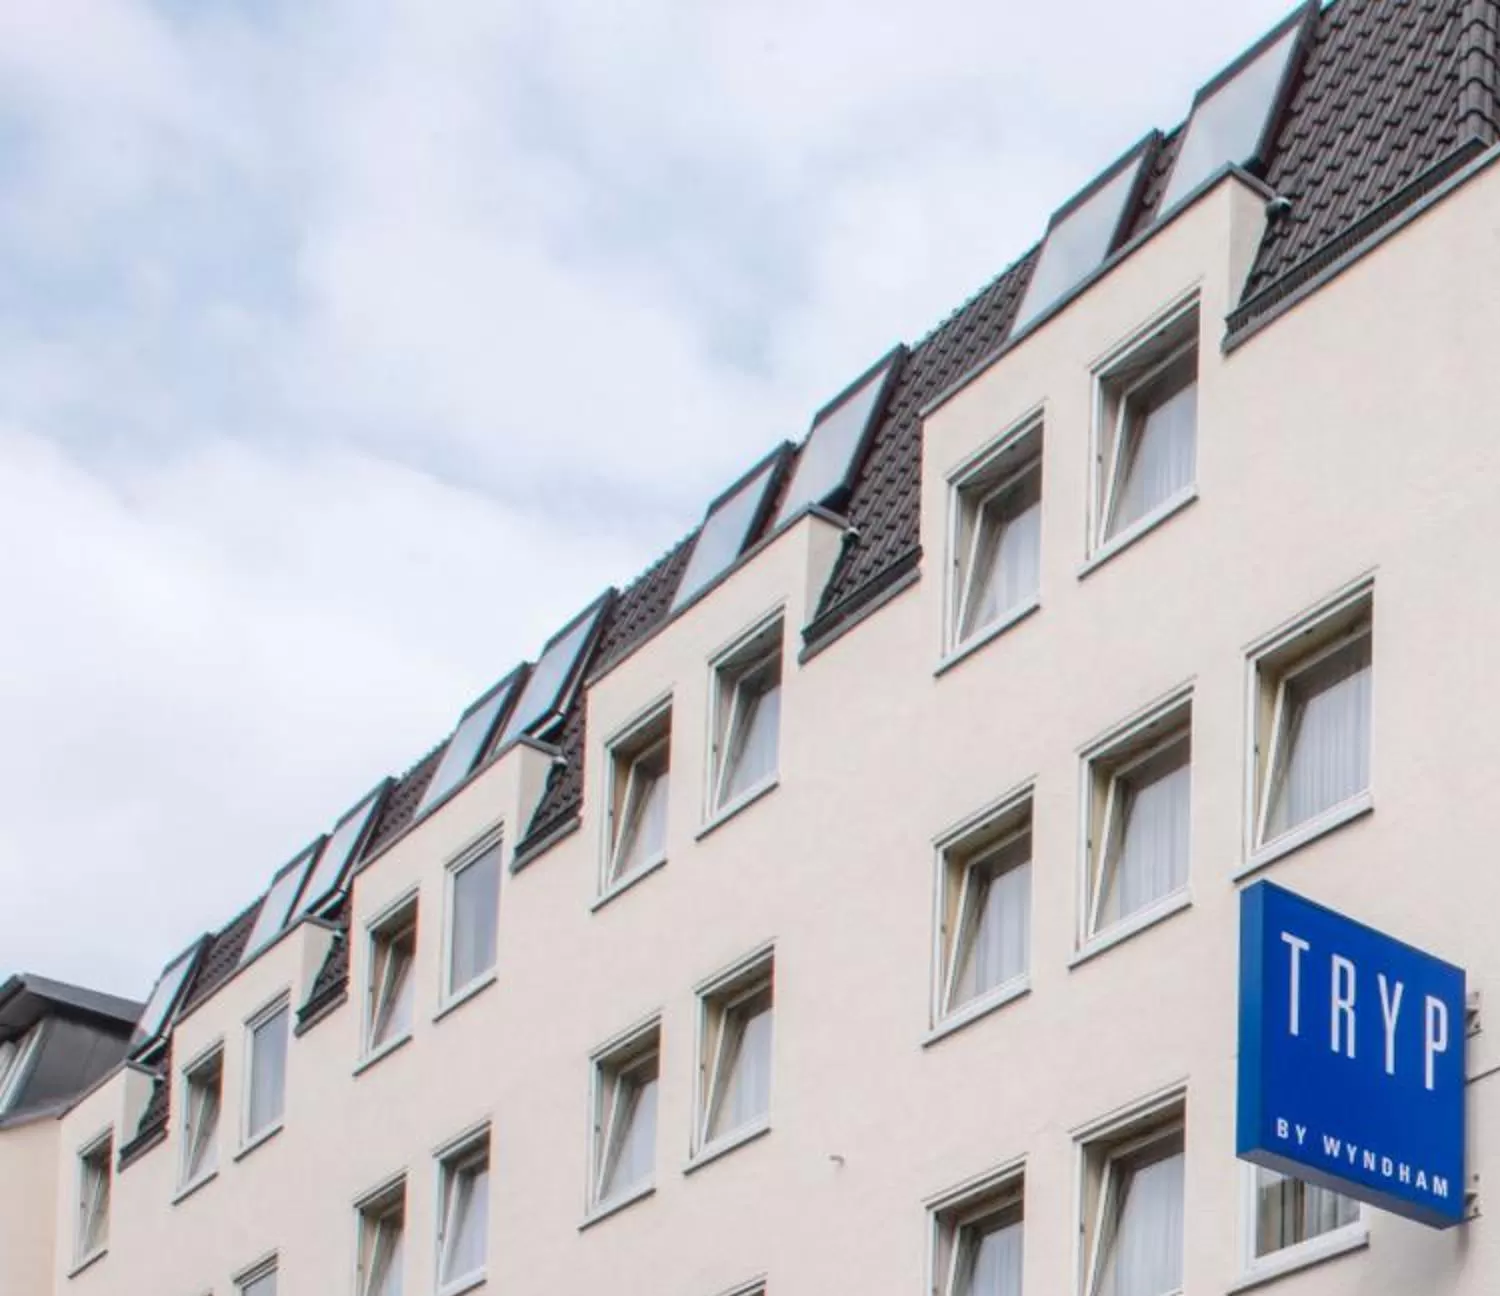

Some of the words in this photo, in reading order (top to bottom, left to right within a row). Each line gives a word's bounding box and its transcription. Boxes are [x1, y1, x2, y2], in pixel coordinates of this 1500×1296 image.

[1281, 931, 1449, 1091] TRYP
[1276, 1117, 1307, 1145] BY
[1323, 1134, 1449, 1199] WYNDHAM
